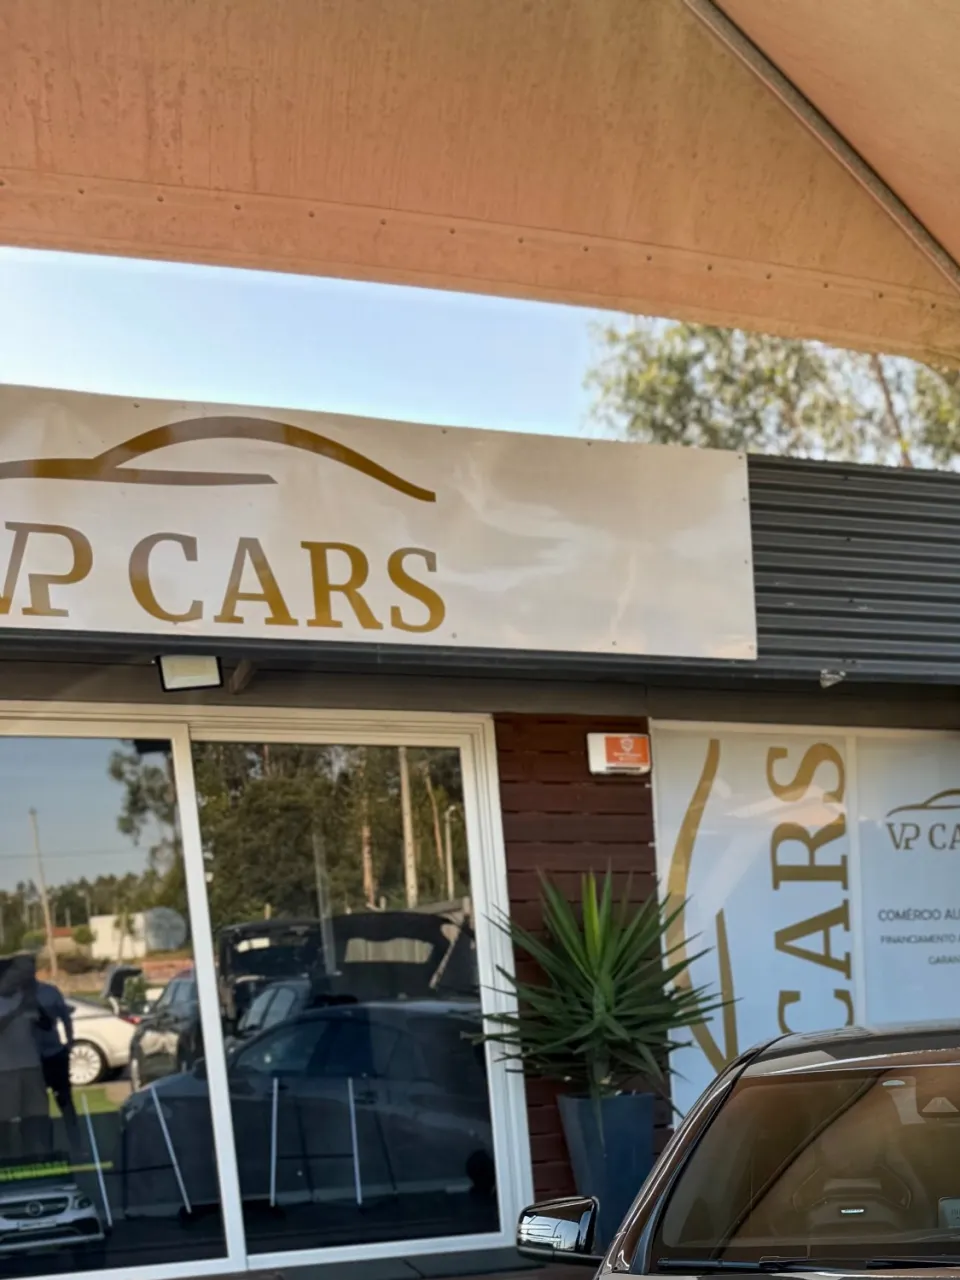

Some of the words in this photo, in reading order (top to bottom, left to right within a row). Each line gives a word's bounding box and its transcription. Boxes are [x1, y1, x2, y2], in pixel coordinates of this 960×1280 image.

[128, 532, 447, 634] CARS
[886, 823, 921, 850] VP
[766, 742, 854, 1035] CARS
[878, 906, 942, 921] COMÉRCIO
